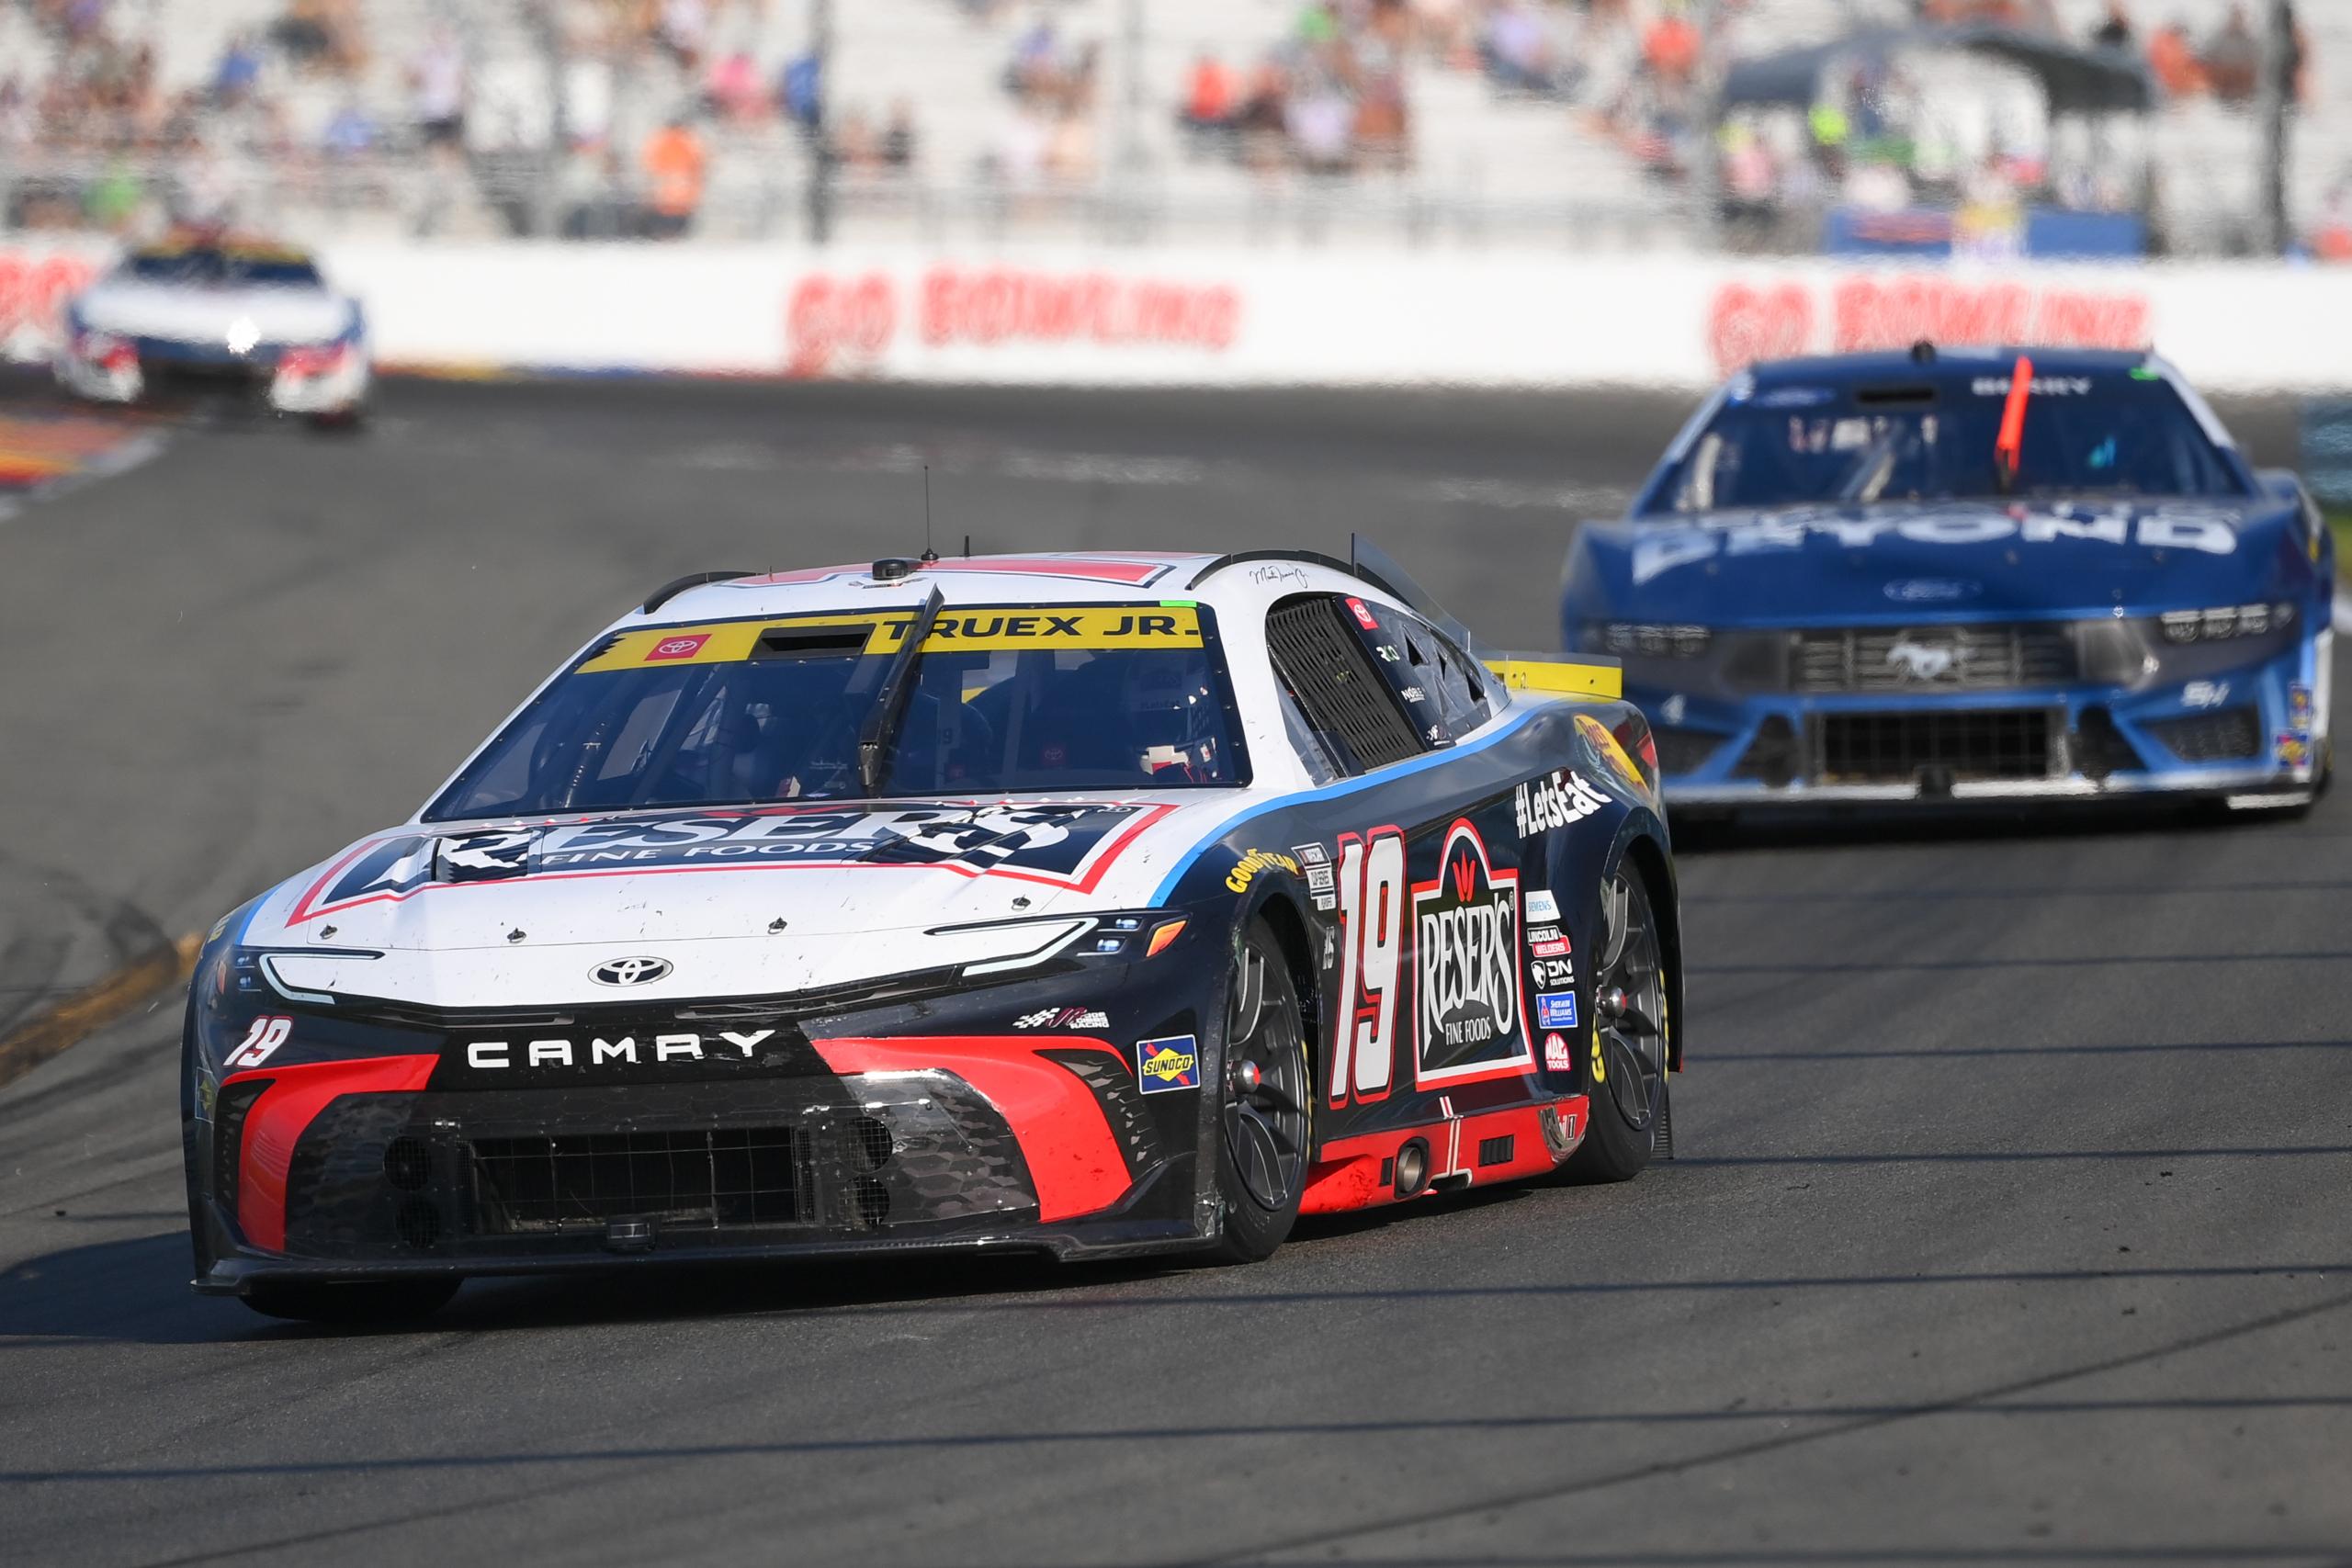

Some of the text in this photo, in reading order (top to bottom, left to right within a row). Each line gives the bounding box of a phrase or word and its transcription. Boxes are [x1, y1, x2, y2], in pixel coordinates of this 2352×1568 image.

[883, 615, 1199, 640] TRUEX JR.
[1515, 771, 1612, 839] #LetsEat
[542, 848, 660, 865] FINE
[684, 840, 874, 858] FOODS
[1528, 929, 1559, 943] LINCOLN
[1330, 832, 1405, 1100] 19
[1421, 892, 1513, 1060] RESER'S
[1545, 959, 1573, 977] DN
[222, 1017, 292, 1066] 19
[1445, 1017, 1492, 1045] FINE FOODS
[468, 1030, 775, 1067] CAMRY
[1545, 1035, 1567, 1059] MAC
[1146, 1056, 1192, 1074] SUNOCO
[1547, 1059, 1569, 1069] TOOLS
